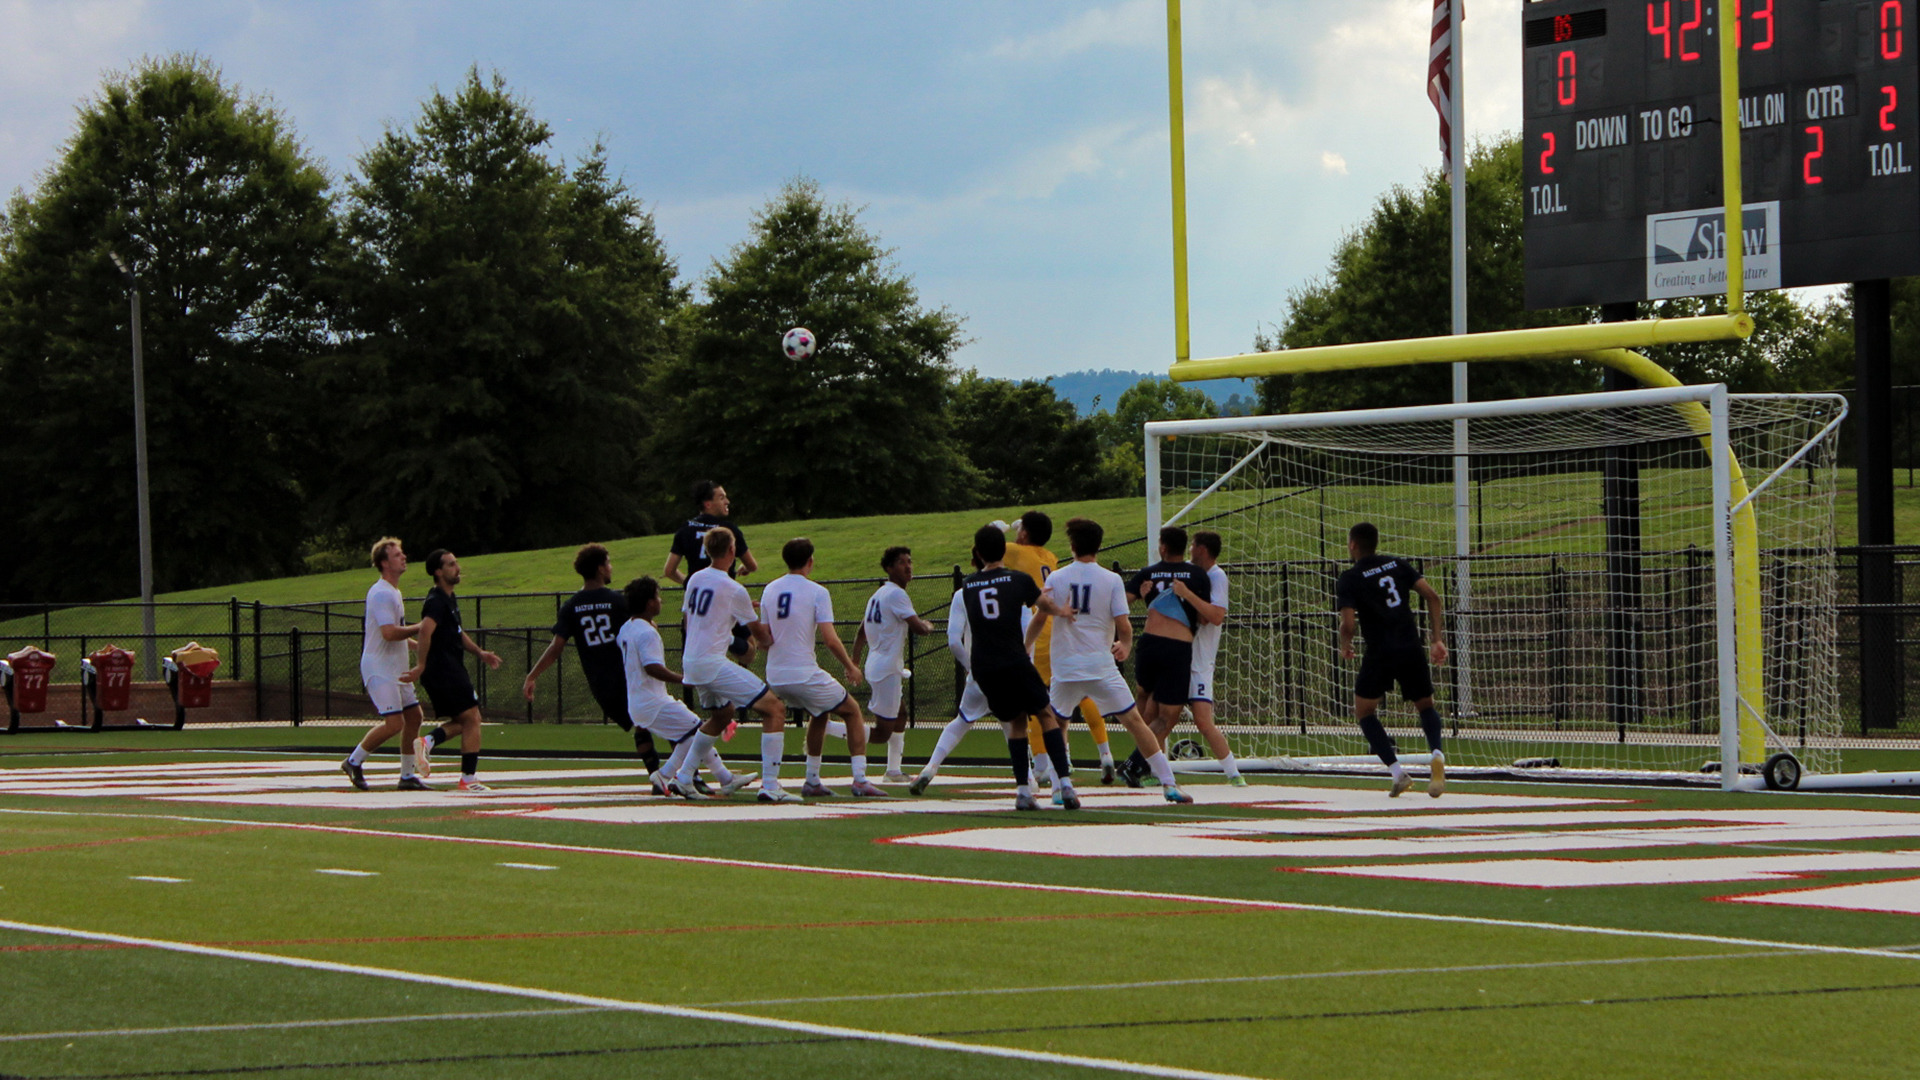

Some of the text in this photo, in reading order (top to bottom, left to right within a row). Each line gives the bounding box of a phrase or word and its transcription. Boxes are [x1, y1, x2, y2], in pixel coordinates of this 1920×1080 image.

[1881, 0, 1902, 59] 0
[1558, 50, 1576, 105] 0
[1738, 93, 1785, 129] ALL ON
[1806, 85, 1844, 120] QTR
[1879, 85, 1896, 131] 2
[1576, 115, 1626, 150] DOWN
[1640, 105, 1692, 141] TO GO
[1540, 132, 1556, 174] 2
[1803, 126, 1823, 184] 2
[1868, 142, 1911, 176] T.O.L.
[1531, 183, 1567, 215] T.O.L.
[1697, 219, 1764, 260] Shw
[1654, 271, 1696, 290] Creating
[1699, 274, 1705, 284] a
[991, 576, 1012, 584] STATE
[1378, 575, 1402, 608] 3
[688, 587, 714, 616] 40
[777, 592, 792, 619] 9
[979, 587, 1000, 619] 6
[1070, 583, 1092, 615] 11
[580, 613, 615, 647] 22
[24, 674, 44, 689] 77
[107, 672, 127, 687] 77
[1198, 684, 1205, 696] 2
